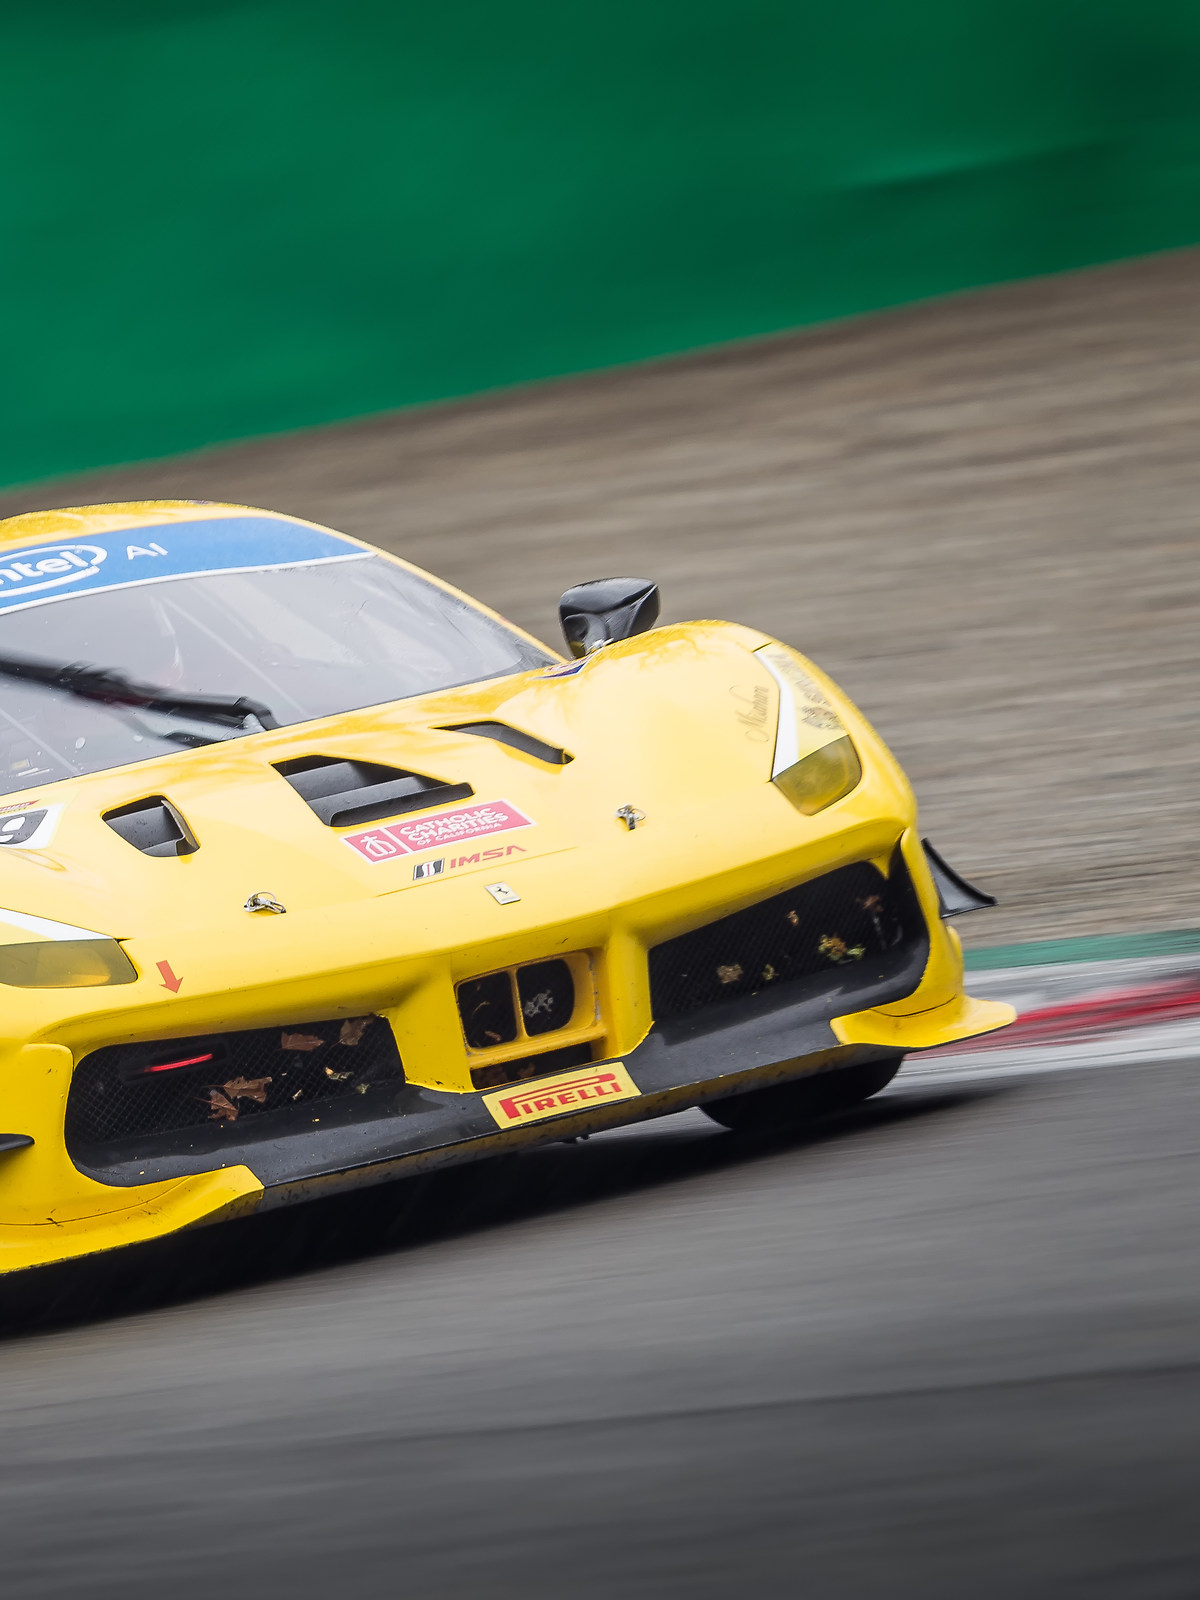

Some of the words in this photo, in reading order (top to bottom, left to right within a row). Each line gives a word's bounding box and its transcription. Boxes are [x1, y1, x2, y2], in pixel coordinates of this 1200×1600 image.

[126, 543, 168, 561] AI
[400, 808, 495, 836] CATHOLIC
[407, 813, 509, 842] CHARITIES
[416, 838, 432, 846] OF
[435, 823, 501, 842] CALIFORNIA
[450, 845, 527, 868] IMSA
[498, 1073, 623, 1119] PIRELLI
